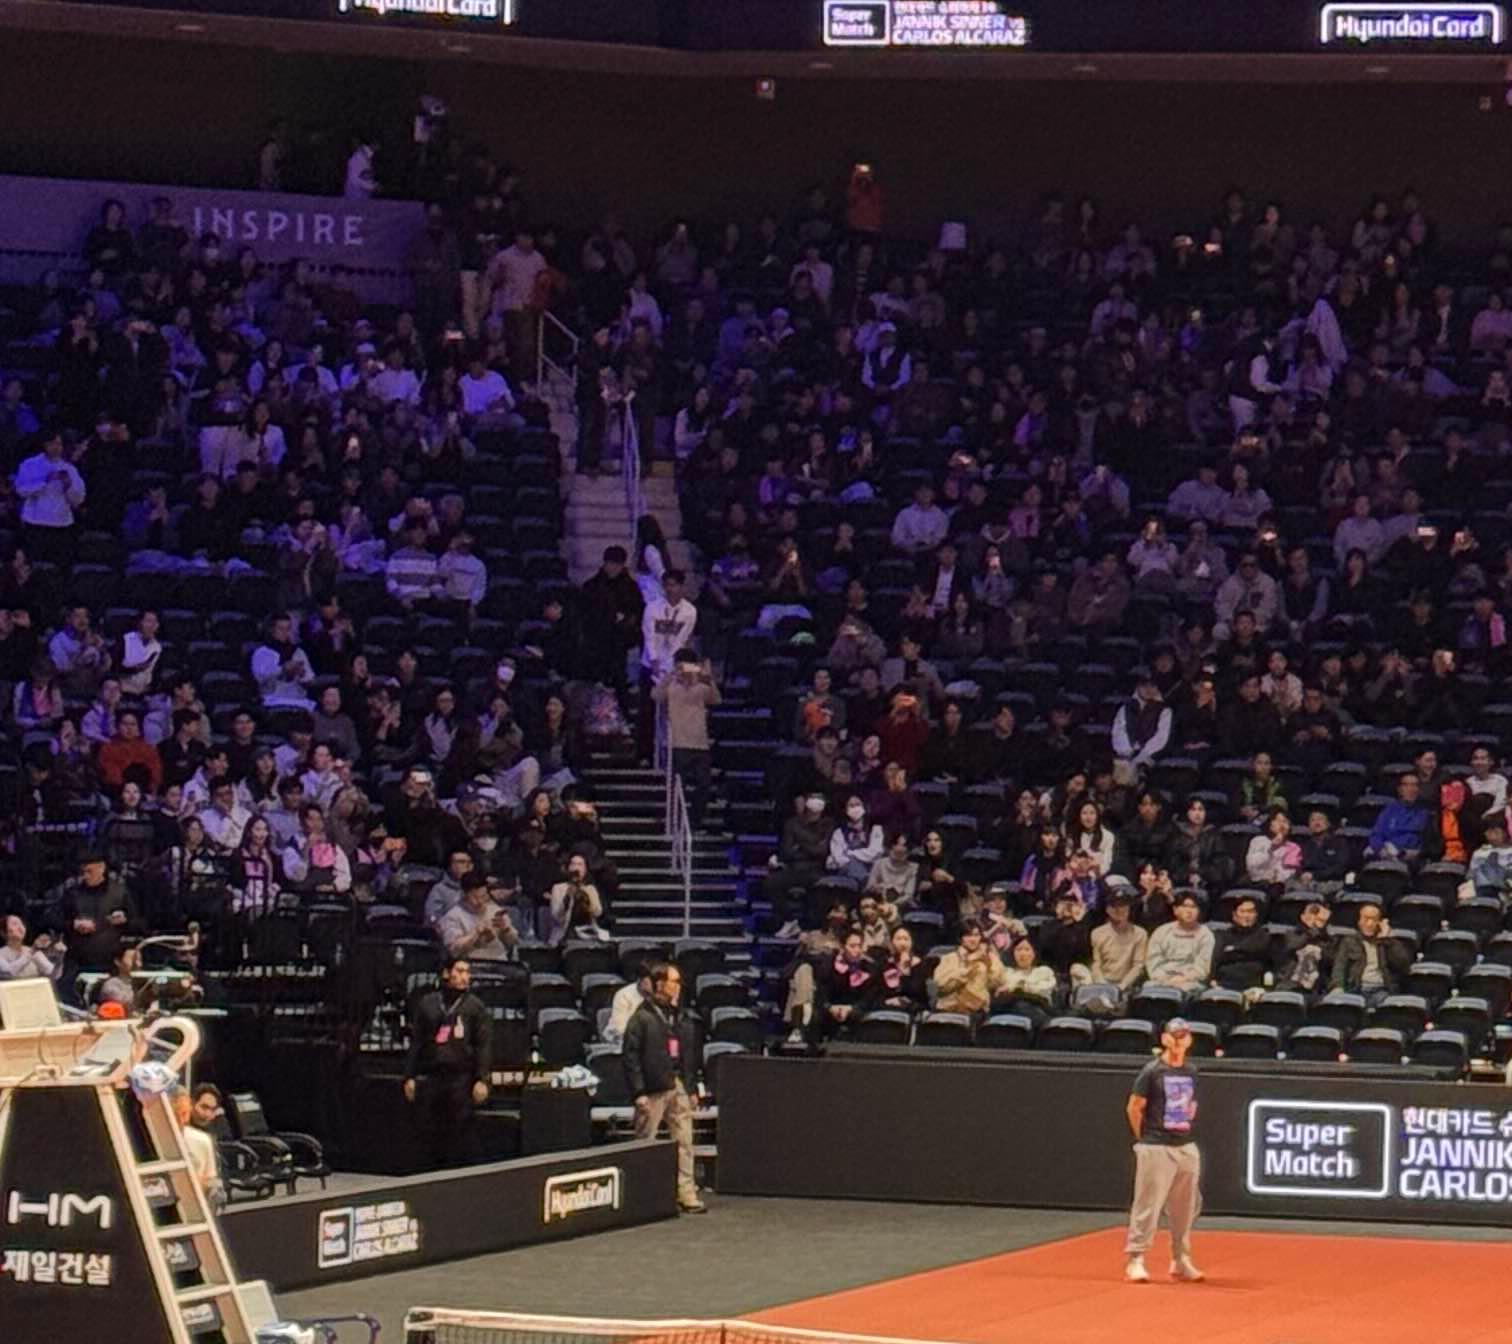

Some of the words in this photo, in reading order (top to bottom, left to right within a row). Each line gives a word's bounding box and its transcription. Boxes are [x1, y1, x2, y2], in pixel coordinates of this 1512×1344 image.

[892, 29, 952, 45] CARLOS
[954, 29, 1026, 45] ALCARAZ
[1336, 14, 1430, 43] Hyundai
[1432, 14, 1484, 38] Card
[193, 207, 363, 246] INSPIRE
[1265, 1117, 1348, 1150] Super
[1402, 1106, 1495, 1136] 현대카드
[1265, 1149, 1354, 1178] Match
[8, 1190, 111, 1229] HM
